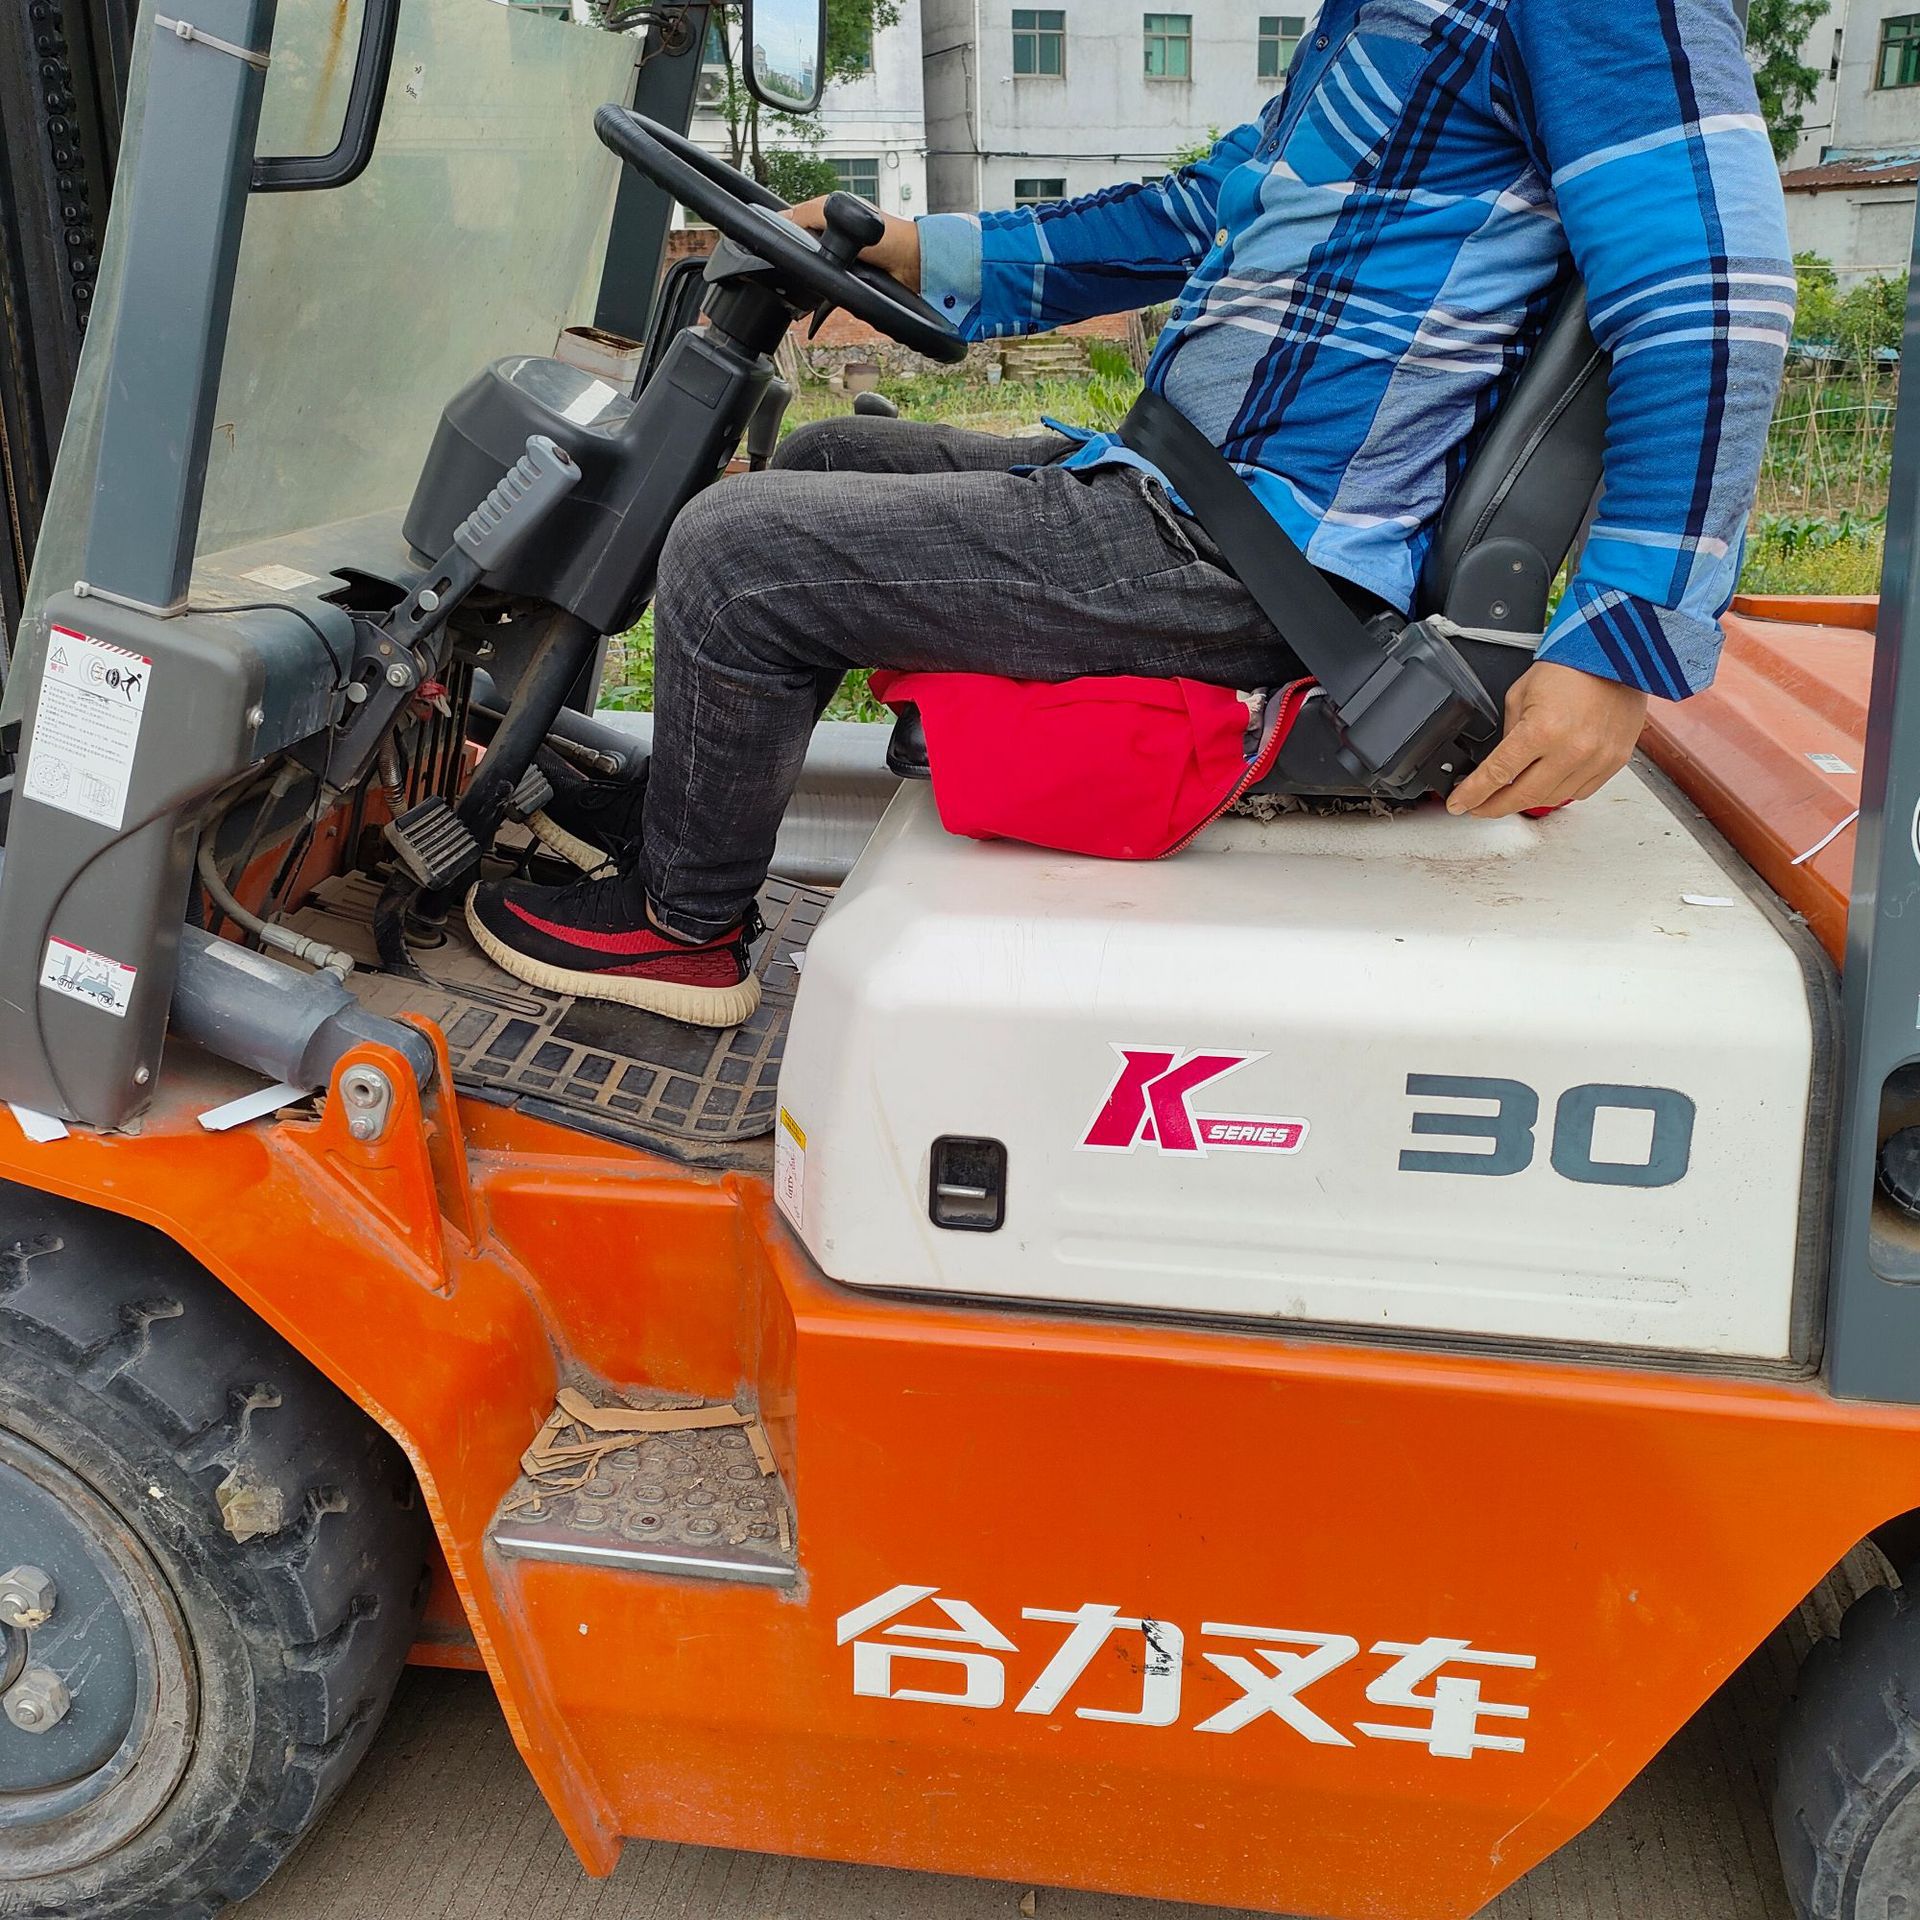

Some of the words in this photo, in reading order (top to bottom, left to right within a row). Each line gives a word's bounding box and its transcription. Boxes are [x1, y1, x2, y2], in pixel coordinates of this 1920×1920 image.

[59, 977, 74, 990] 970
[99, 992, 114, 1006] 790
[1080, 1048, 1250, 1152] K
[1207, 1124, 1290, 1144] SERIES
[1398, 1072, 1697, 1188] 30
[836, 1584, 1538, 1760] 合力叉车
